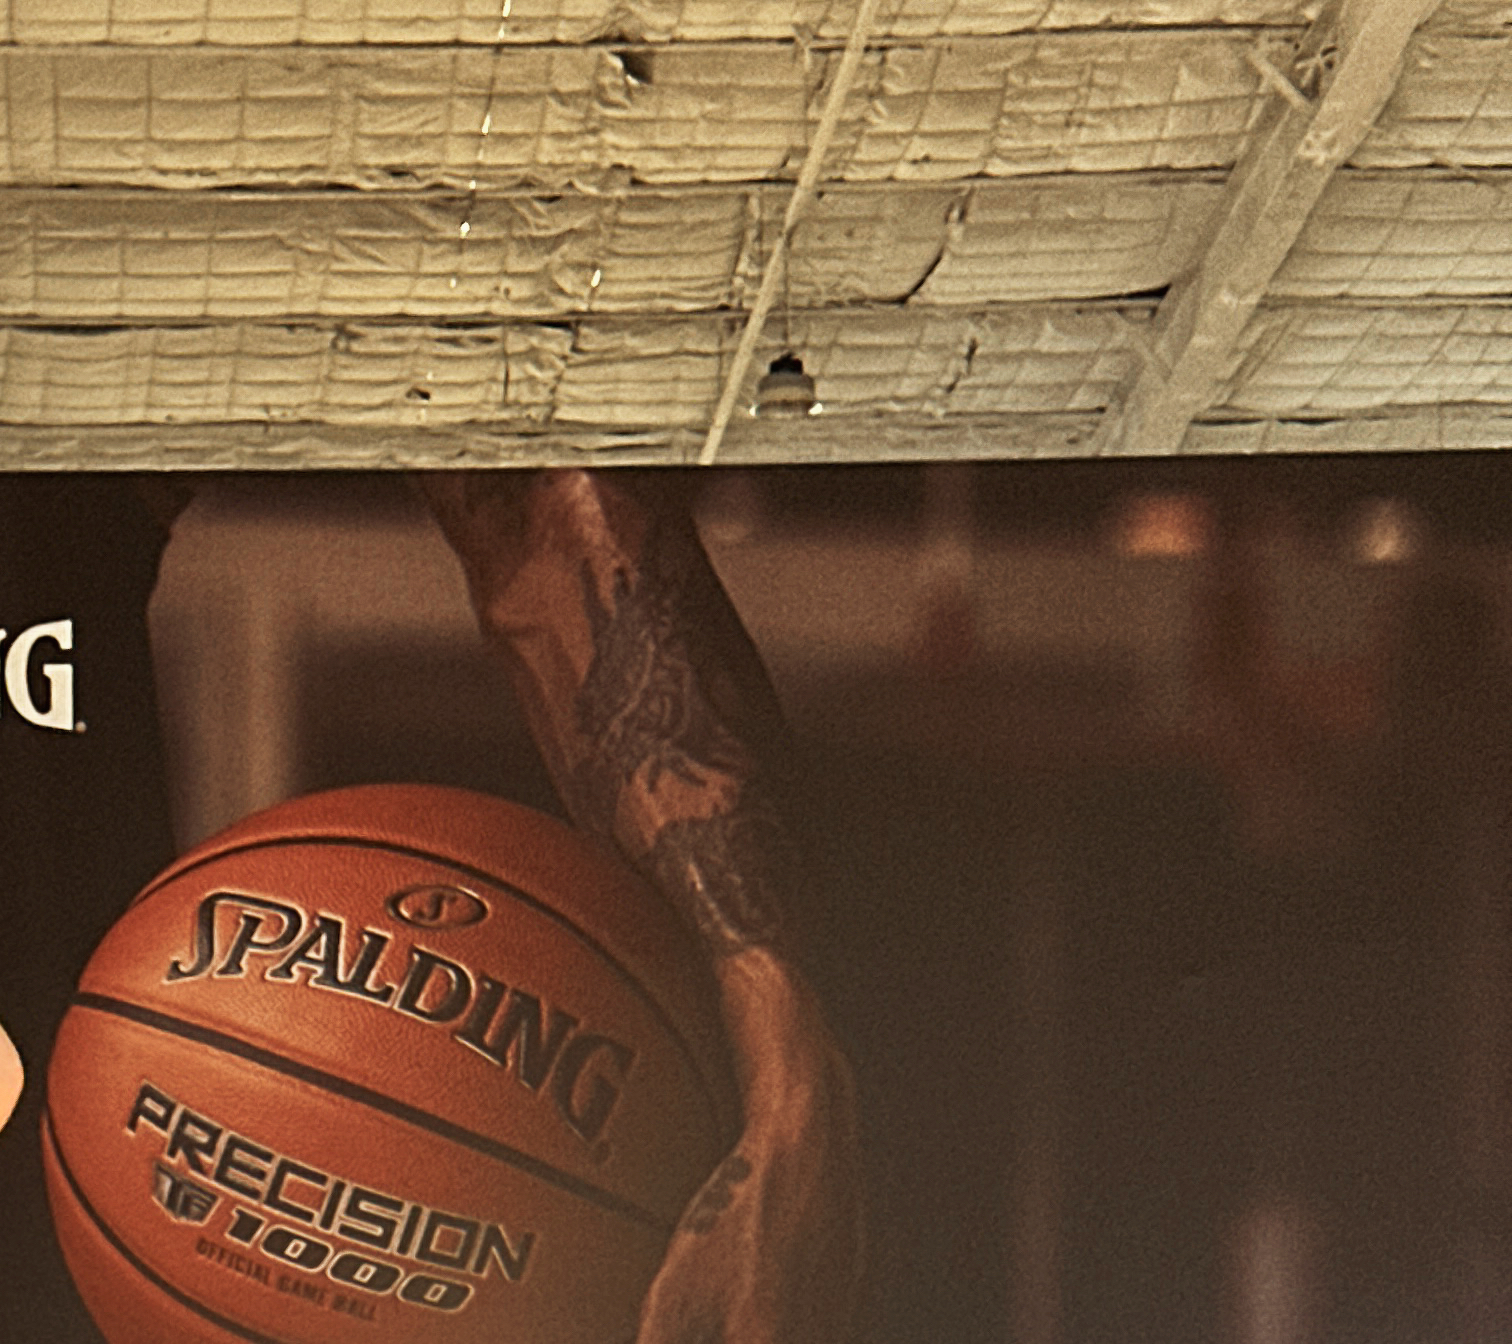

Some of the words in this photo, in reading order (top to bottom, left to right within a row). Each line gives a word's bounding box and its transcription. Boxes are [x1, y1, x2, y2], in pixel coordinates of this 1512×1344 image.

[163, 888, 638, 1142] SPALDING
[126, 1080, 536, 1283] PRECISION
[226, 1207, 474, 1312] 1000
